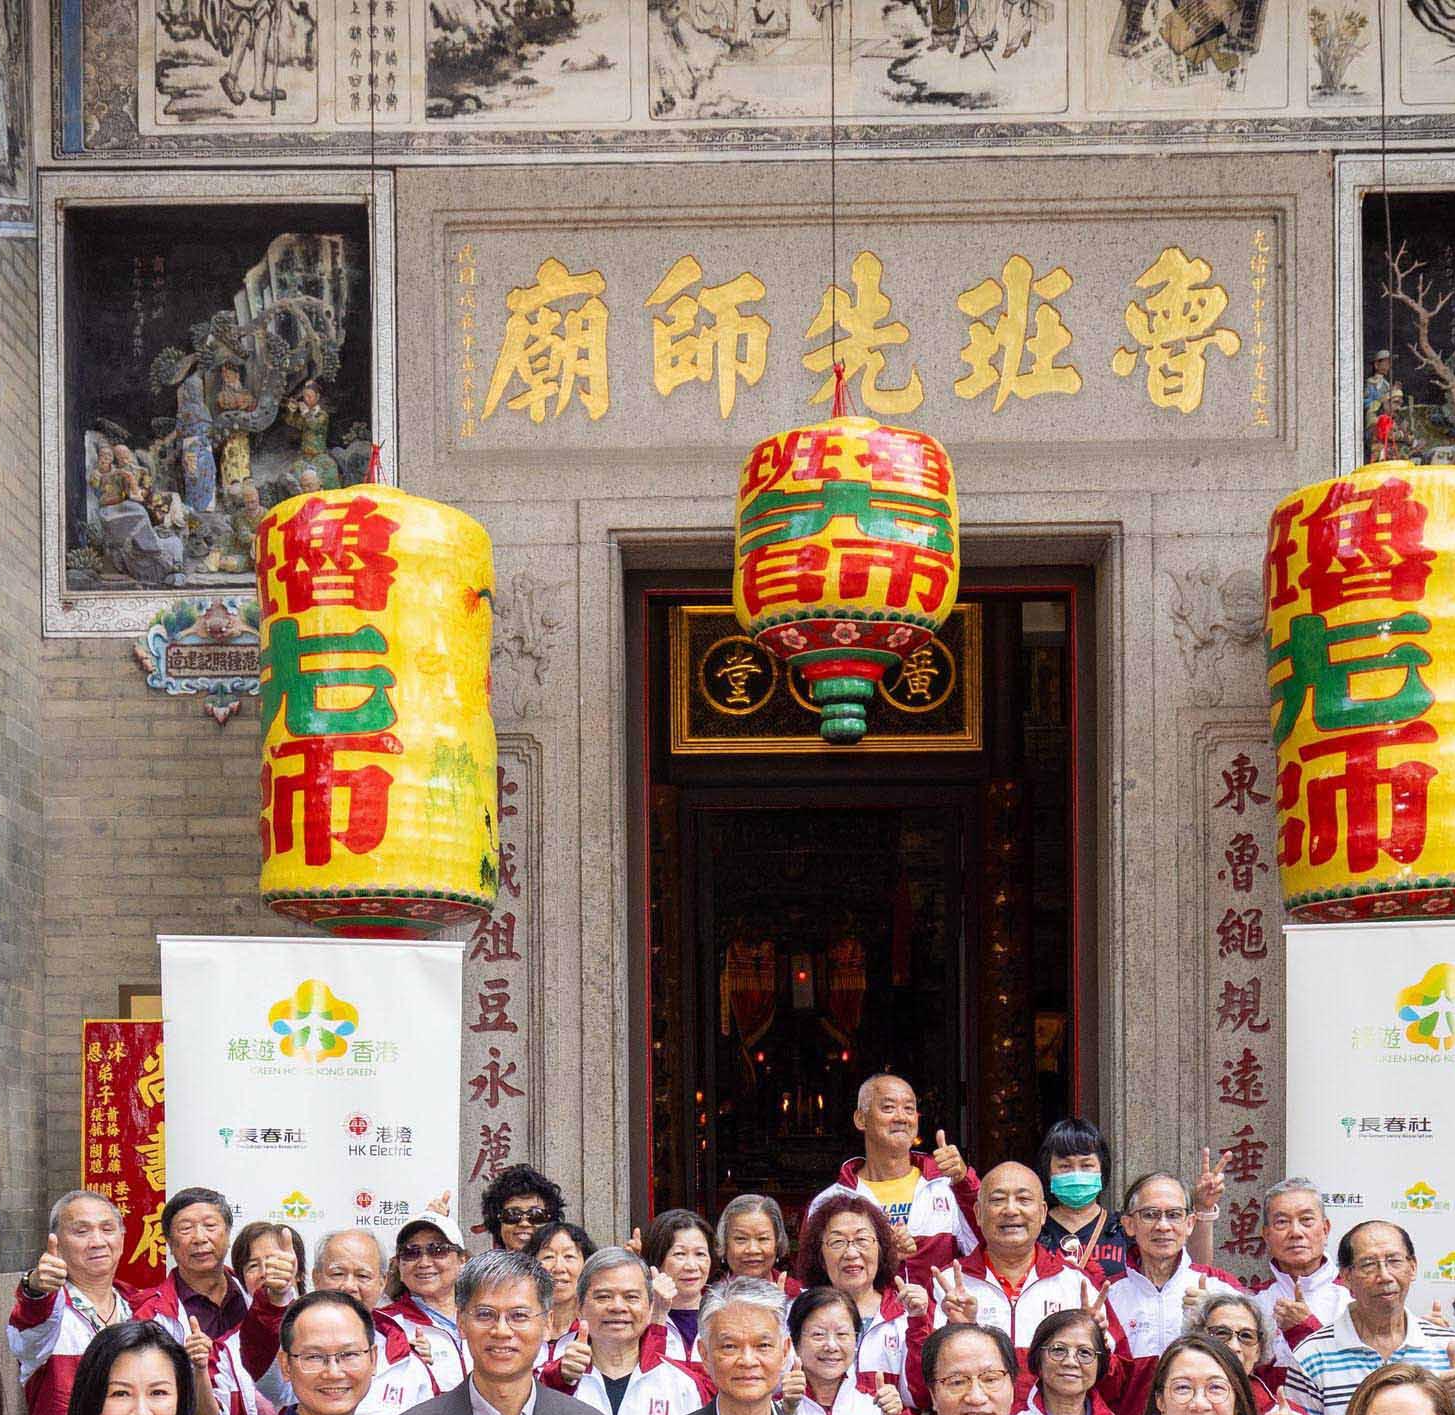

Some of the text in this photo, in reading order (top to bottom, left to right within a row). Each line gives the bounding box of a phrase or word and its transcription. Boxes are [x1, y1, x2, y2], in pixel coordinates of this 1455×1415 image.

[1358, 1117, 1433, 1133] 長春社
[376, 1126, 413, 1144] 港燈
[348, 1144, 413, 1157] HK Electric
[379, 1200, 410, 1215] 港燈
[356, 1215, 371, 1226] HK
